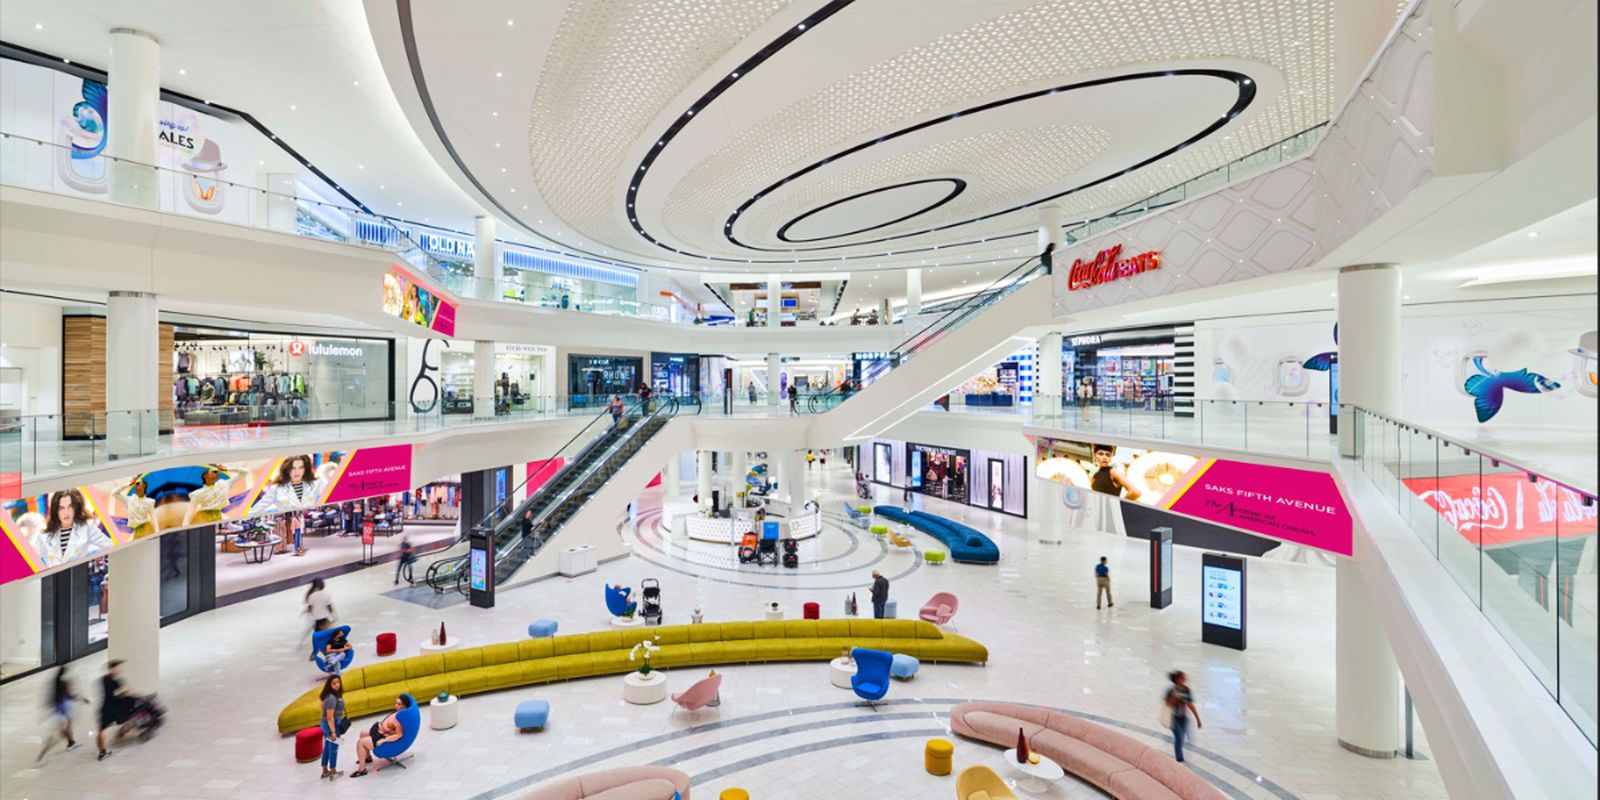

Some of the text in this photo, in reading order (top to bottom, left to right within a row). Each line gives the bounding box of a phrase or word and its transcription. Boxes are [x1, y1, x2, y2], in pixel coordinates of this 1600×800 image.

[430, 234, 476, 257] OLD NA
[1119, 251, 1159, 278] EATS
[308, 343, 363, 356] lululemon
[1204, 483, 1336, 515] SAKS FIFTH AVENUE
